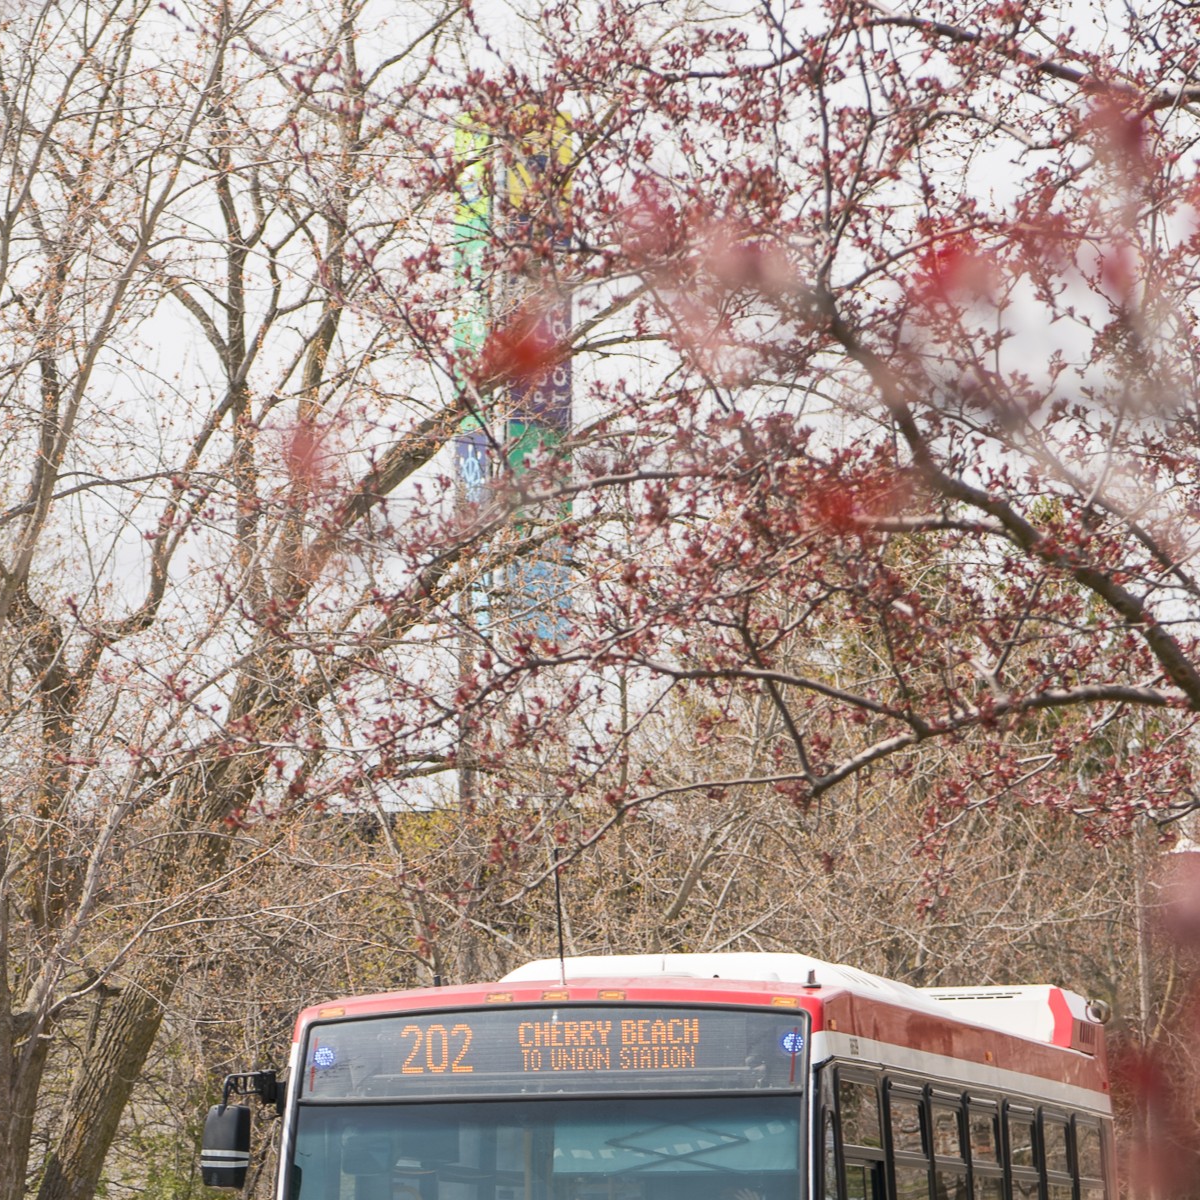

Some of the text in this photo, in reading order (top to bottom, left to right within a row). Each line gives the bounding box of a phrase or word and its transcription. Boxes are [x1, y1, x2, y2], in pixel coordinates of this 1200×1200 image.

[517, 1018, 700, 1047] CHERRY BEACH
[400, 1023, 474, 1074] 202
[521, 1045, 696, 1072] TO UNION STATION
